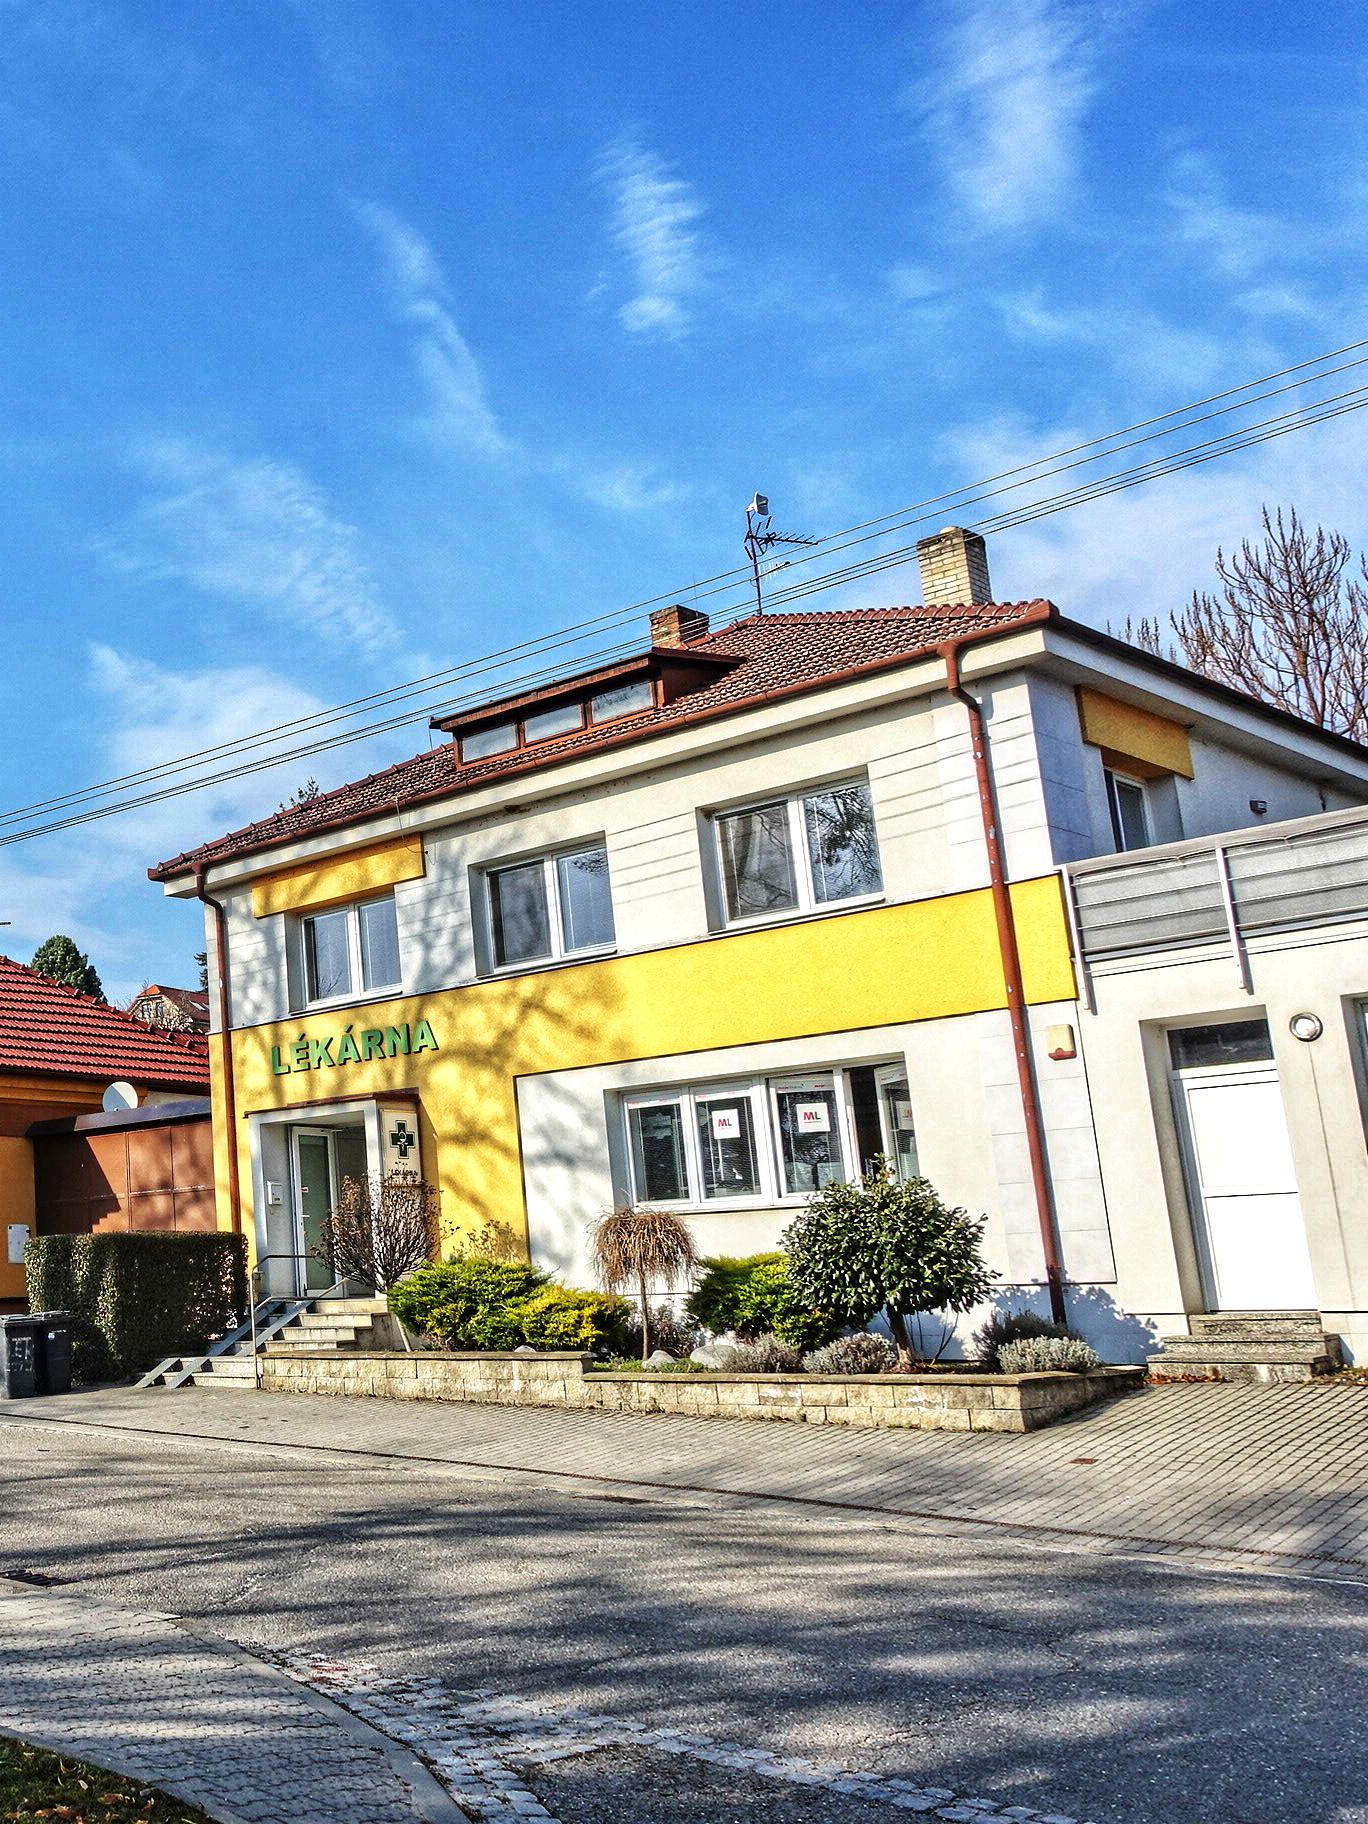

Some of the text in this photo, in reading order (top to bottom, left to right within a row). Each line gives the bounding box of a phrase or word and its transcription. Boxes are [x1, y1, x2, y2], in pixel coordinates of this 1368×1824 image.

[271, 1020, 439, 1075] LÉKÁRNA
[803, 1111, 821, 1121] ML
[718, 1118, 733, 1127] ML
